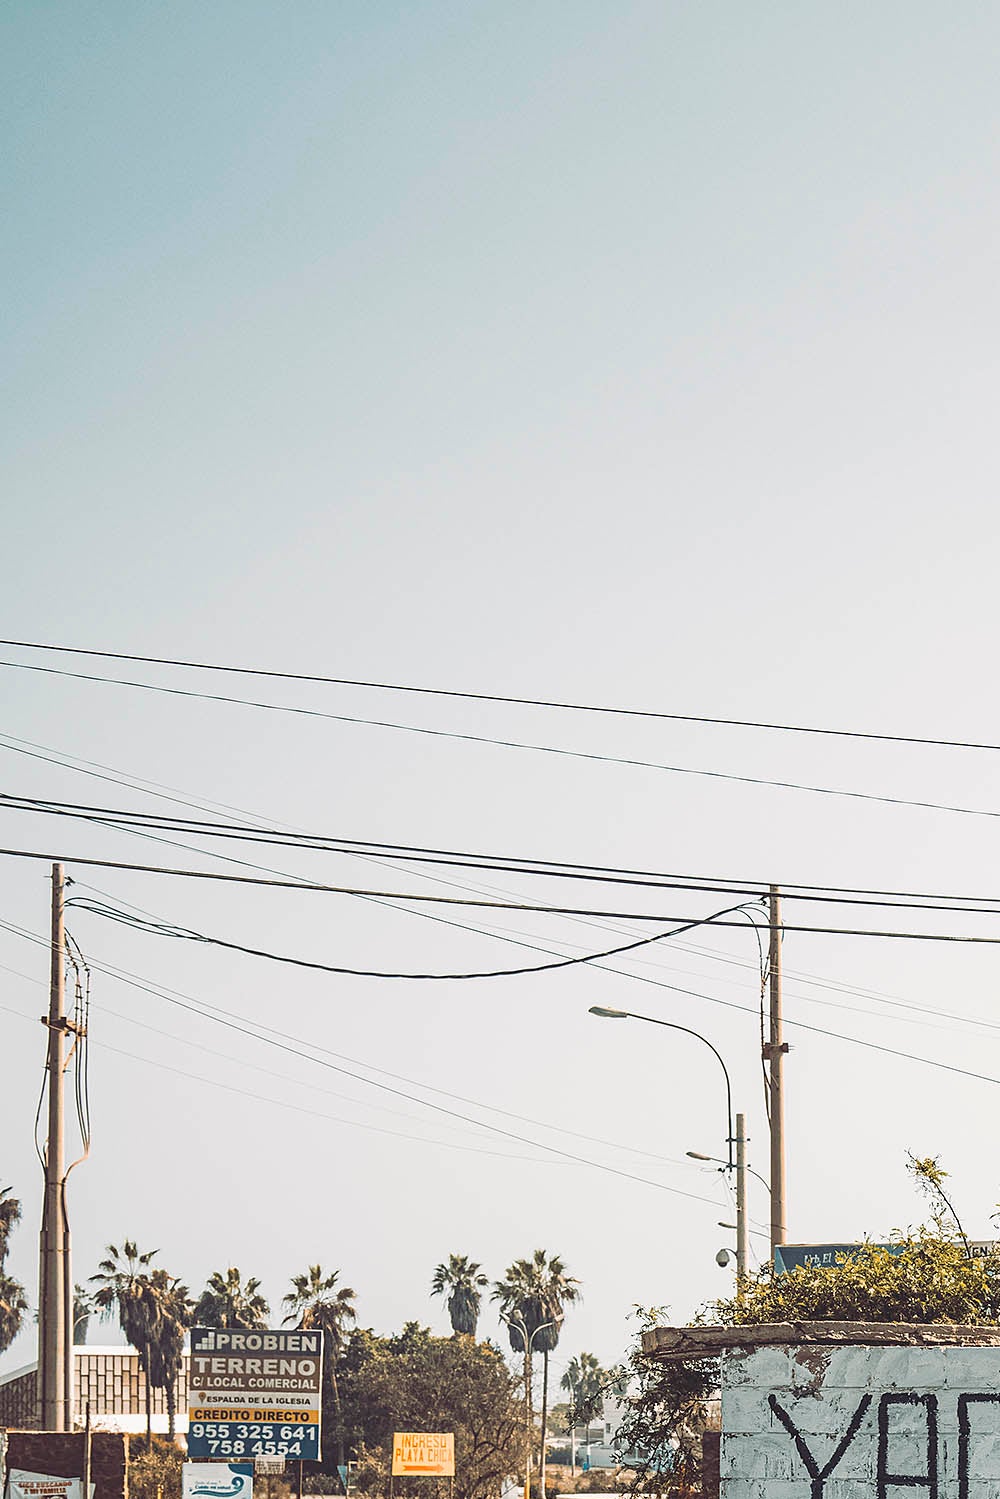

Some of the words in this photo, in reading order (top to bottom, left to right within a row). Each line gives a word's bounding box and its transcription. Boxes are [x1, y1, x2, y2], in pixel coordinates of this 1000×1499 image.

[216, 1333, 317, 1352] PROBIEN
[194, 1357, 316, 1376] TERRENO
[192, 1376, 204, 1387] C/
[207, 1377, 245, 1388] LOCAL
[248, 1378, 317, 1389] COMERCIAL
[206, 1396, 246, 1404] ESPALDA
[248, 1396, 260, 1404] DE
[275, 1397, 311, 1405] IGLESIA
[194, 1409, 250, 1421] CREDITO
[254, 1411, 310, 1422] DIRECTO
[192, 1424, 230, 1439] 955
[236, 1425, 274, 1440] 325
[280, 1426, 316, 1441] 641
[208, 1440, 245, 1455] 758
[251, 1441, 302, 1456] 4554
[401, 1434, 447, 1448] INGRESO
[395, 1447, 424, 1462] PLAYA
[427, 1448, 453, 1464] CHICA
